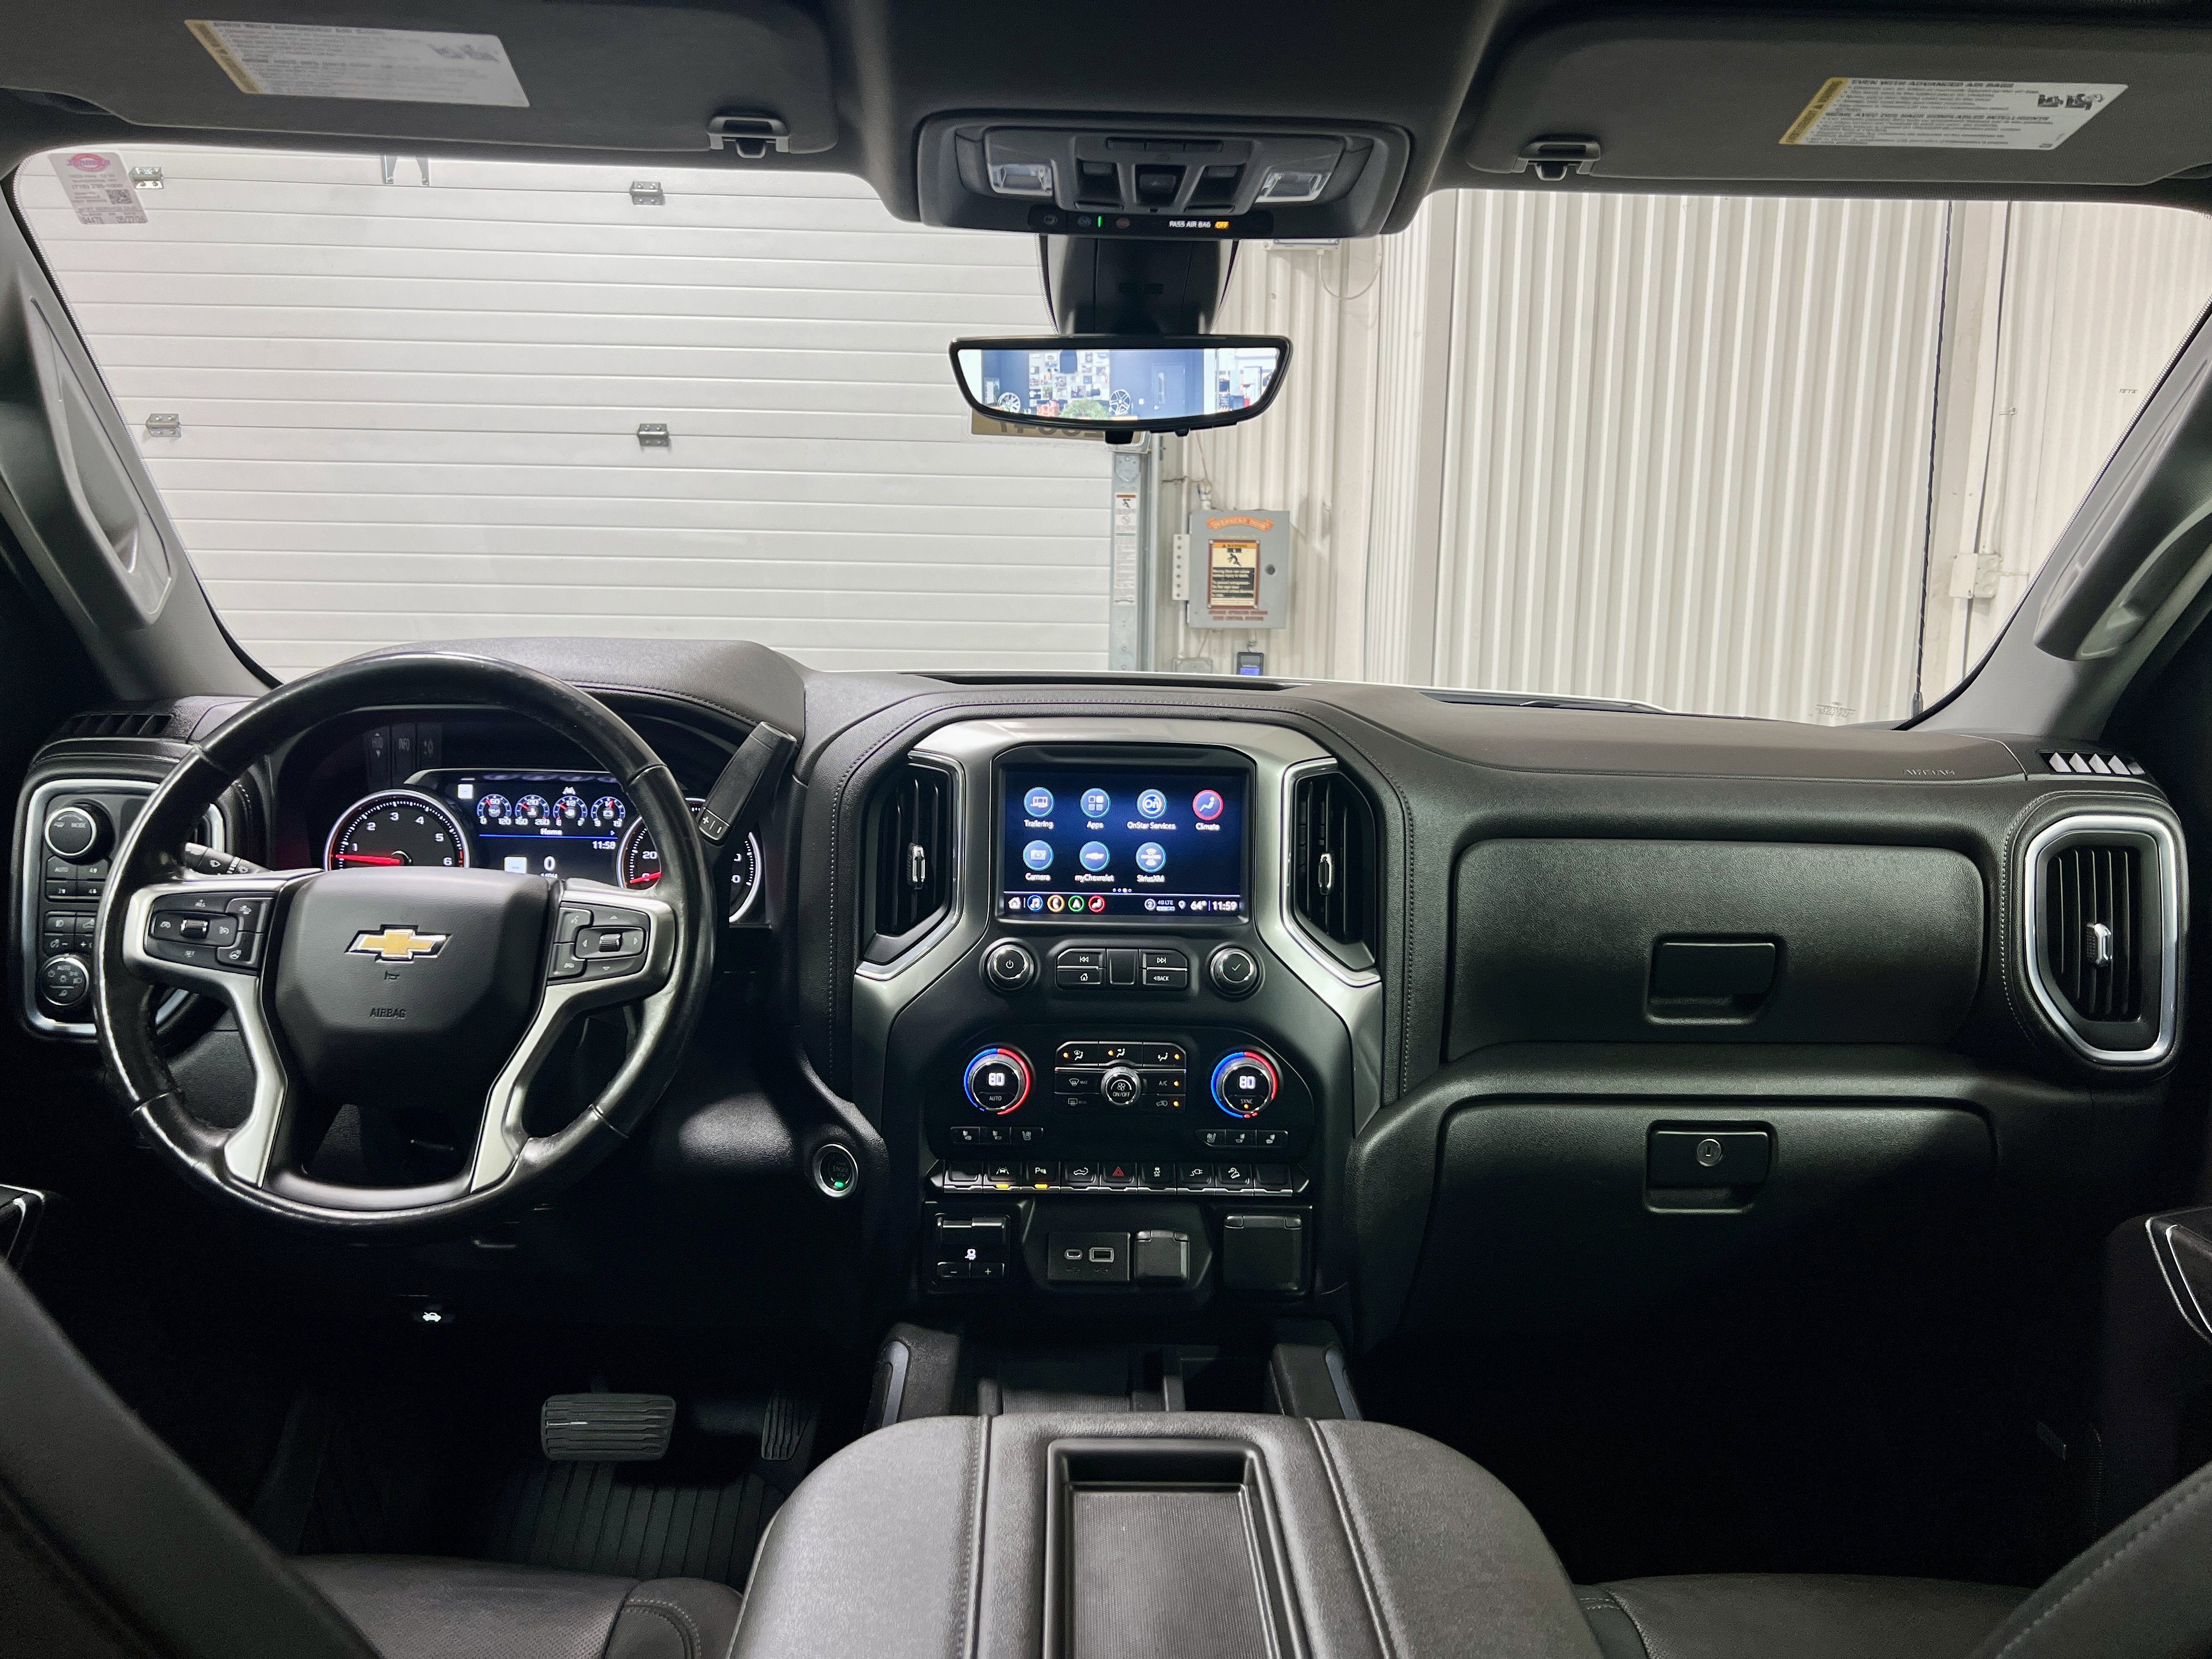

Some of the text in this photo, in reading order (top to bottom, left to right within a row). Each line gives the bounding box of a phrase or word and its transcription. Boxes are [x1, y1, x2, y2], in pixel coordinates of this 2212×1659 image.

[390, 812, 399, 821] 3
[415, 816, 425, 825] 4
[366, 822, 376, 831] 2
[1024, 819, 1053, 830] Trailering
[1087, 821, 1104, 830] Apps
[1127, 821, 1176, 830] OnStar Services
[1195, 822, 1220, 831] Climate
[435, 833, 444, 842] 5
[352, 843, 358, 851] 1
[592, 841, 616, 850] 11:58
[642, 851, 658, 860] 20
[443, 857, 453, 866] 6
[543, 856, 555, 871] 0
[1025, 873, 1051, 881] Camera
[1074, 874, 1115, 883] myChevrolet
[1137, 874, 1165, 883] SiriusXM
[1212, 901, 1238, 911] 11:59
[369, 1007, 407, 1019] AIRBAG
[988, 1073, 1005, 1086] 80
[1239, 1075, 1256, 1090] 80
